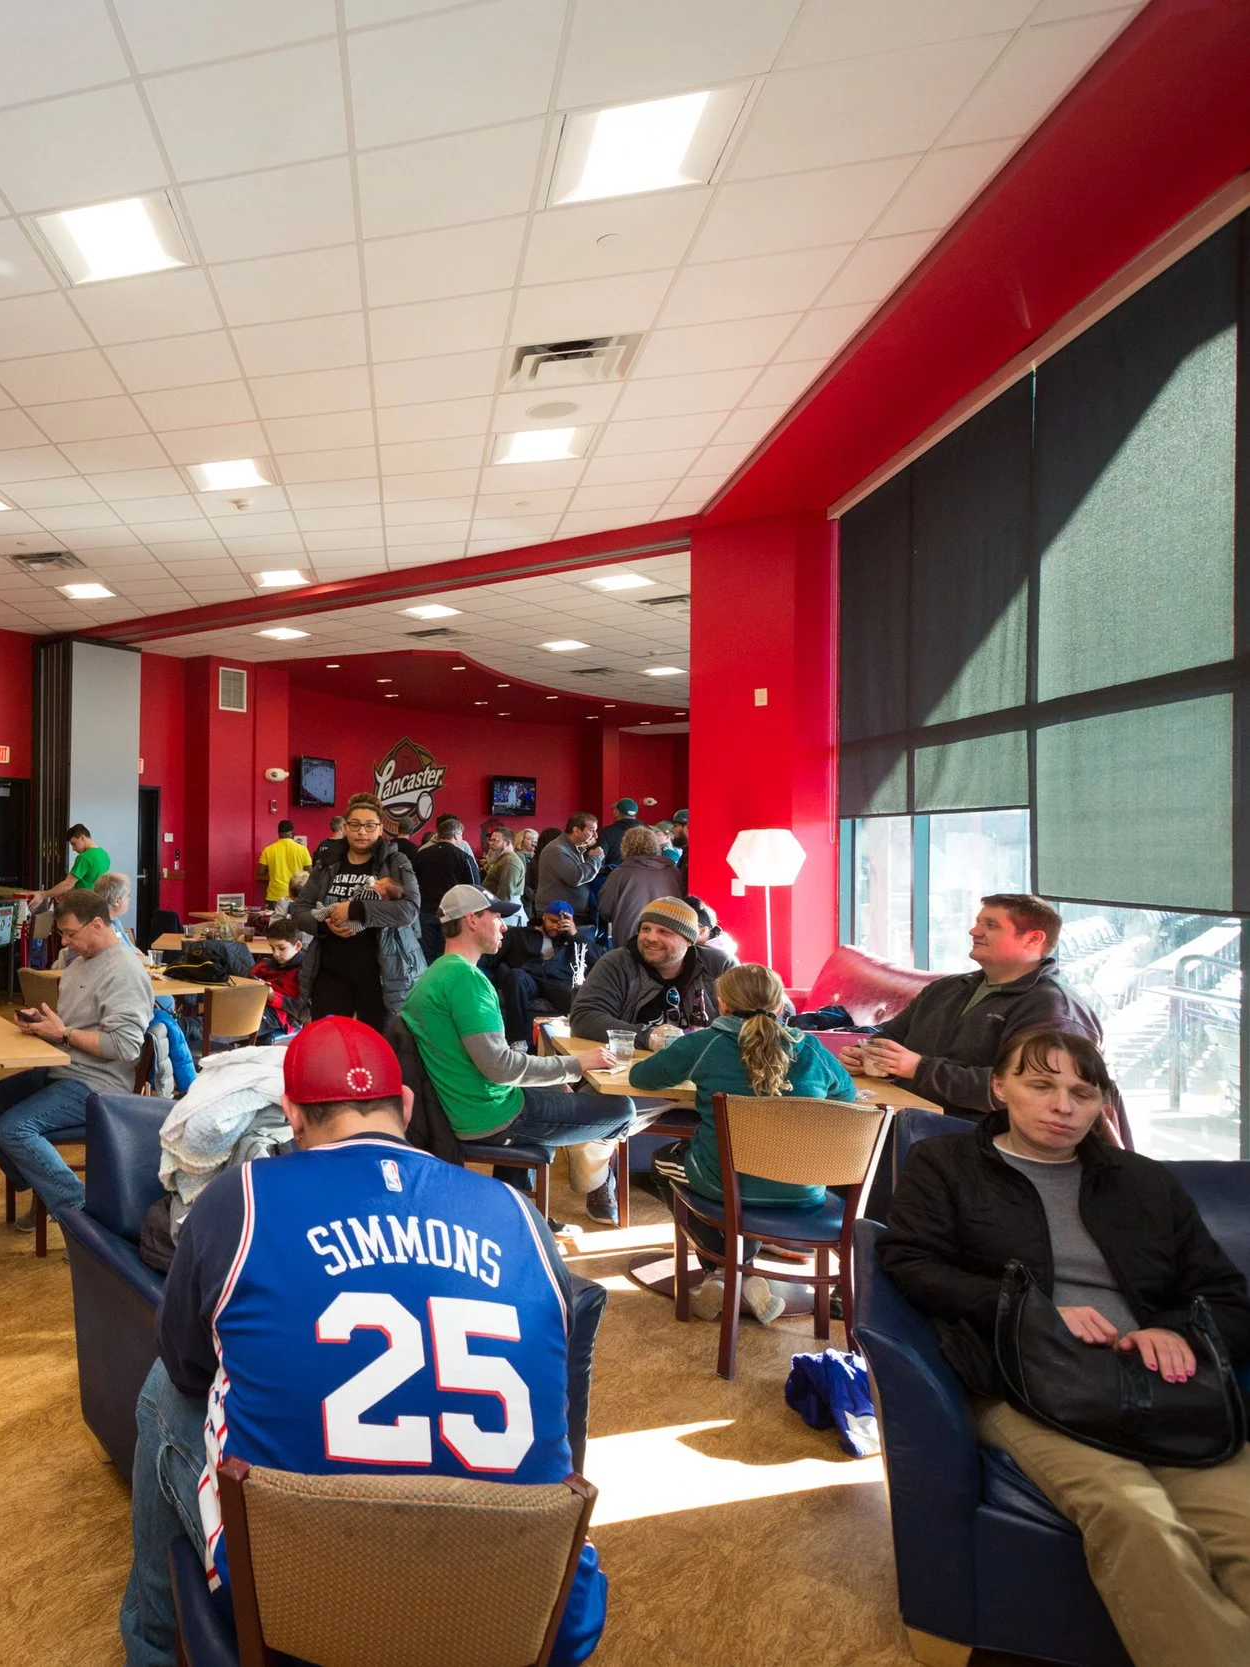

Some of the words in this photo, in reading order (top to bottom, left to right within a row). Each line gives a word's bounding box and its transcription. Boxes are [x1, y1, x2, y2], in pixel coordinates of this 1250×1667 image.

[328, 884, 347, 896] ARE
[306, 1215, 502, 1288] SIMMONS
[315, 1291, 535, 1473] 25
